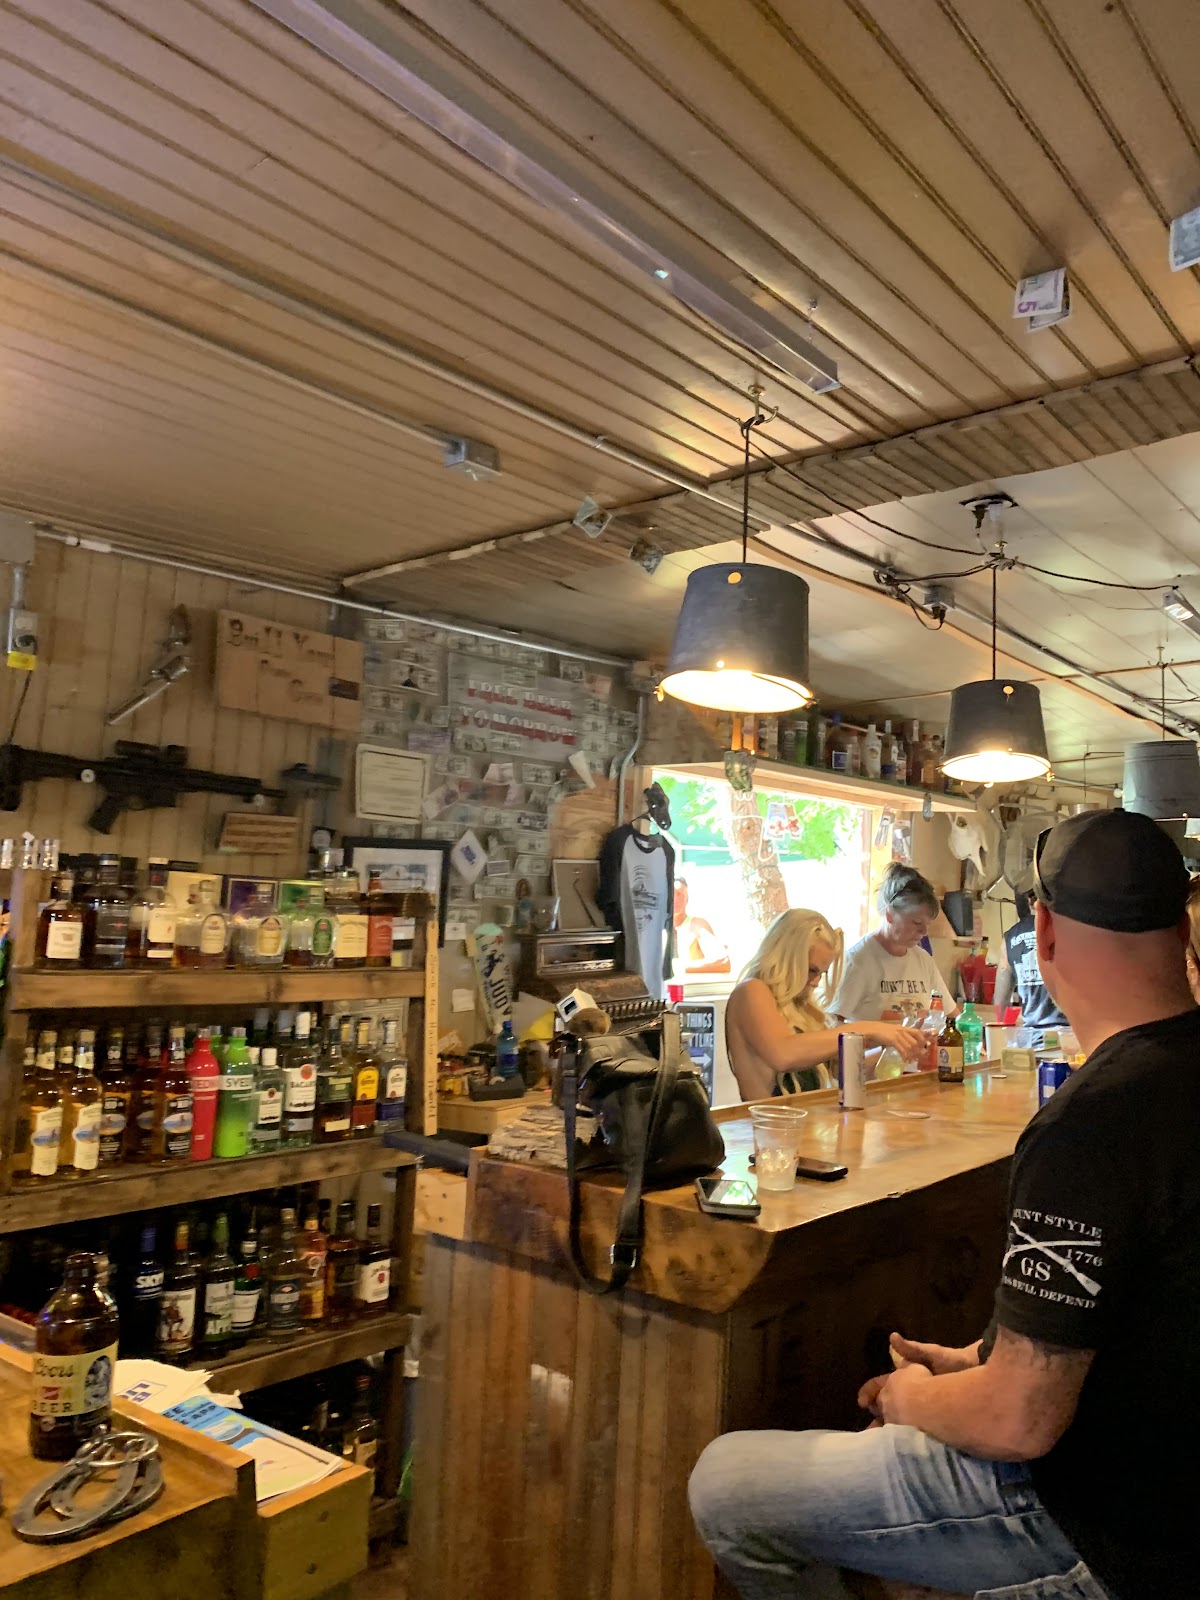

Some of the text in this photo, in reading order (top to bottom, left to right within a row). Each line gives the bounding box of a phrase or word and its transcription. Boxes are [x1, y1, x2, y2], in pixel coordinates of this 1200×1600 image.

[1017, 301, 1037, 313] 5
[907, 980, 919, 993] BE
[686, 1012, 712, 1028] THINGS
[1044, 1214, 1102, 1239] STYLE
[1066, 1248, 1103, 1268] 1776
[1020, 1256, 1052, 1282] GS
[1039, 1288, 1097, 1309] DEFEND
